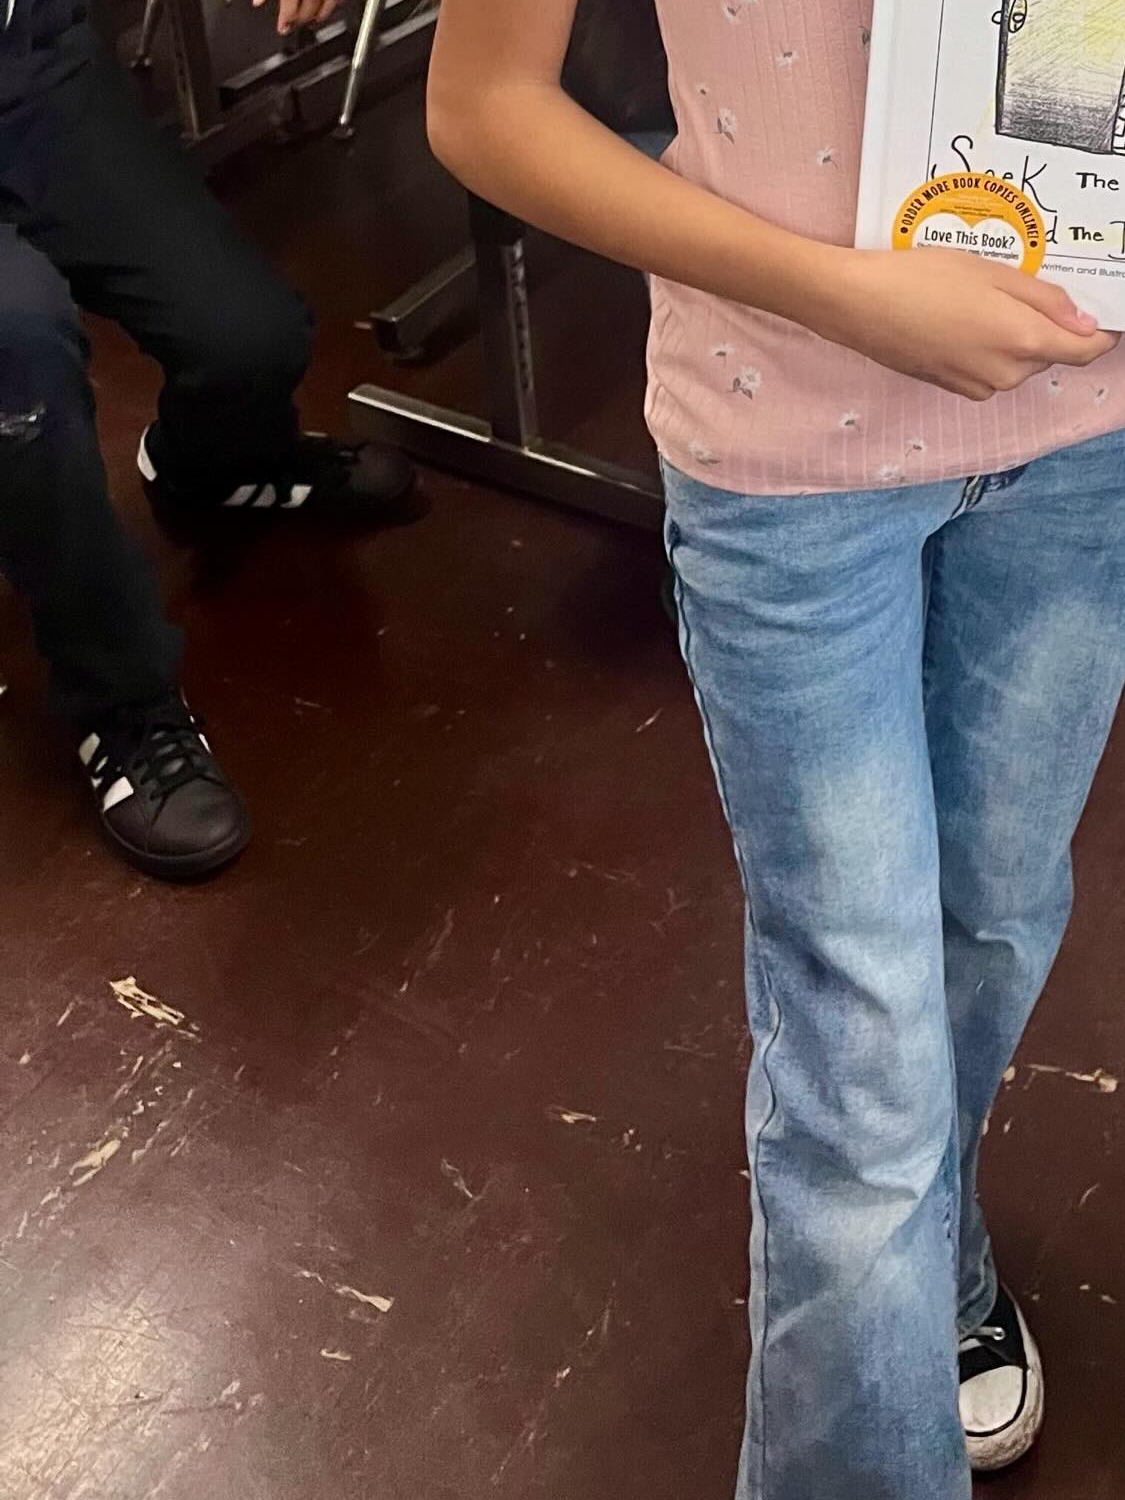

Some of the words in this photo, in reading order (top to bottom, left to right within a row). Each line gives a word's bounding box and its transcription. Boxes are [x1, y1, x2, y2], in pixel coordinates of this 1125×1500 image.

[1075, 172, 1120, 191] The
[902, 198, 926, 226] ORDER
[922, 180, 951, 201] MORE
[952, 177, 980, 189] BOOK
[983, 180, 1019, 204] COPIES
[1015, 202, 1040, 239] ONLINE!
[924, 226, 952, 243] Love
[955, 230, 978, 246] This
[981, 236, 1016, 249] Book?
[1068, 226, 1105, 242] The
[1076, 265, 1097, 276] and
